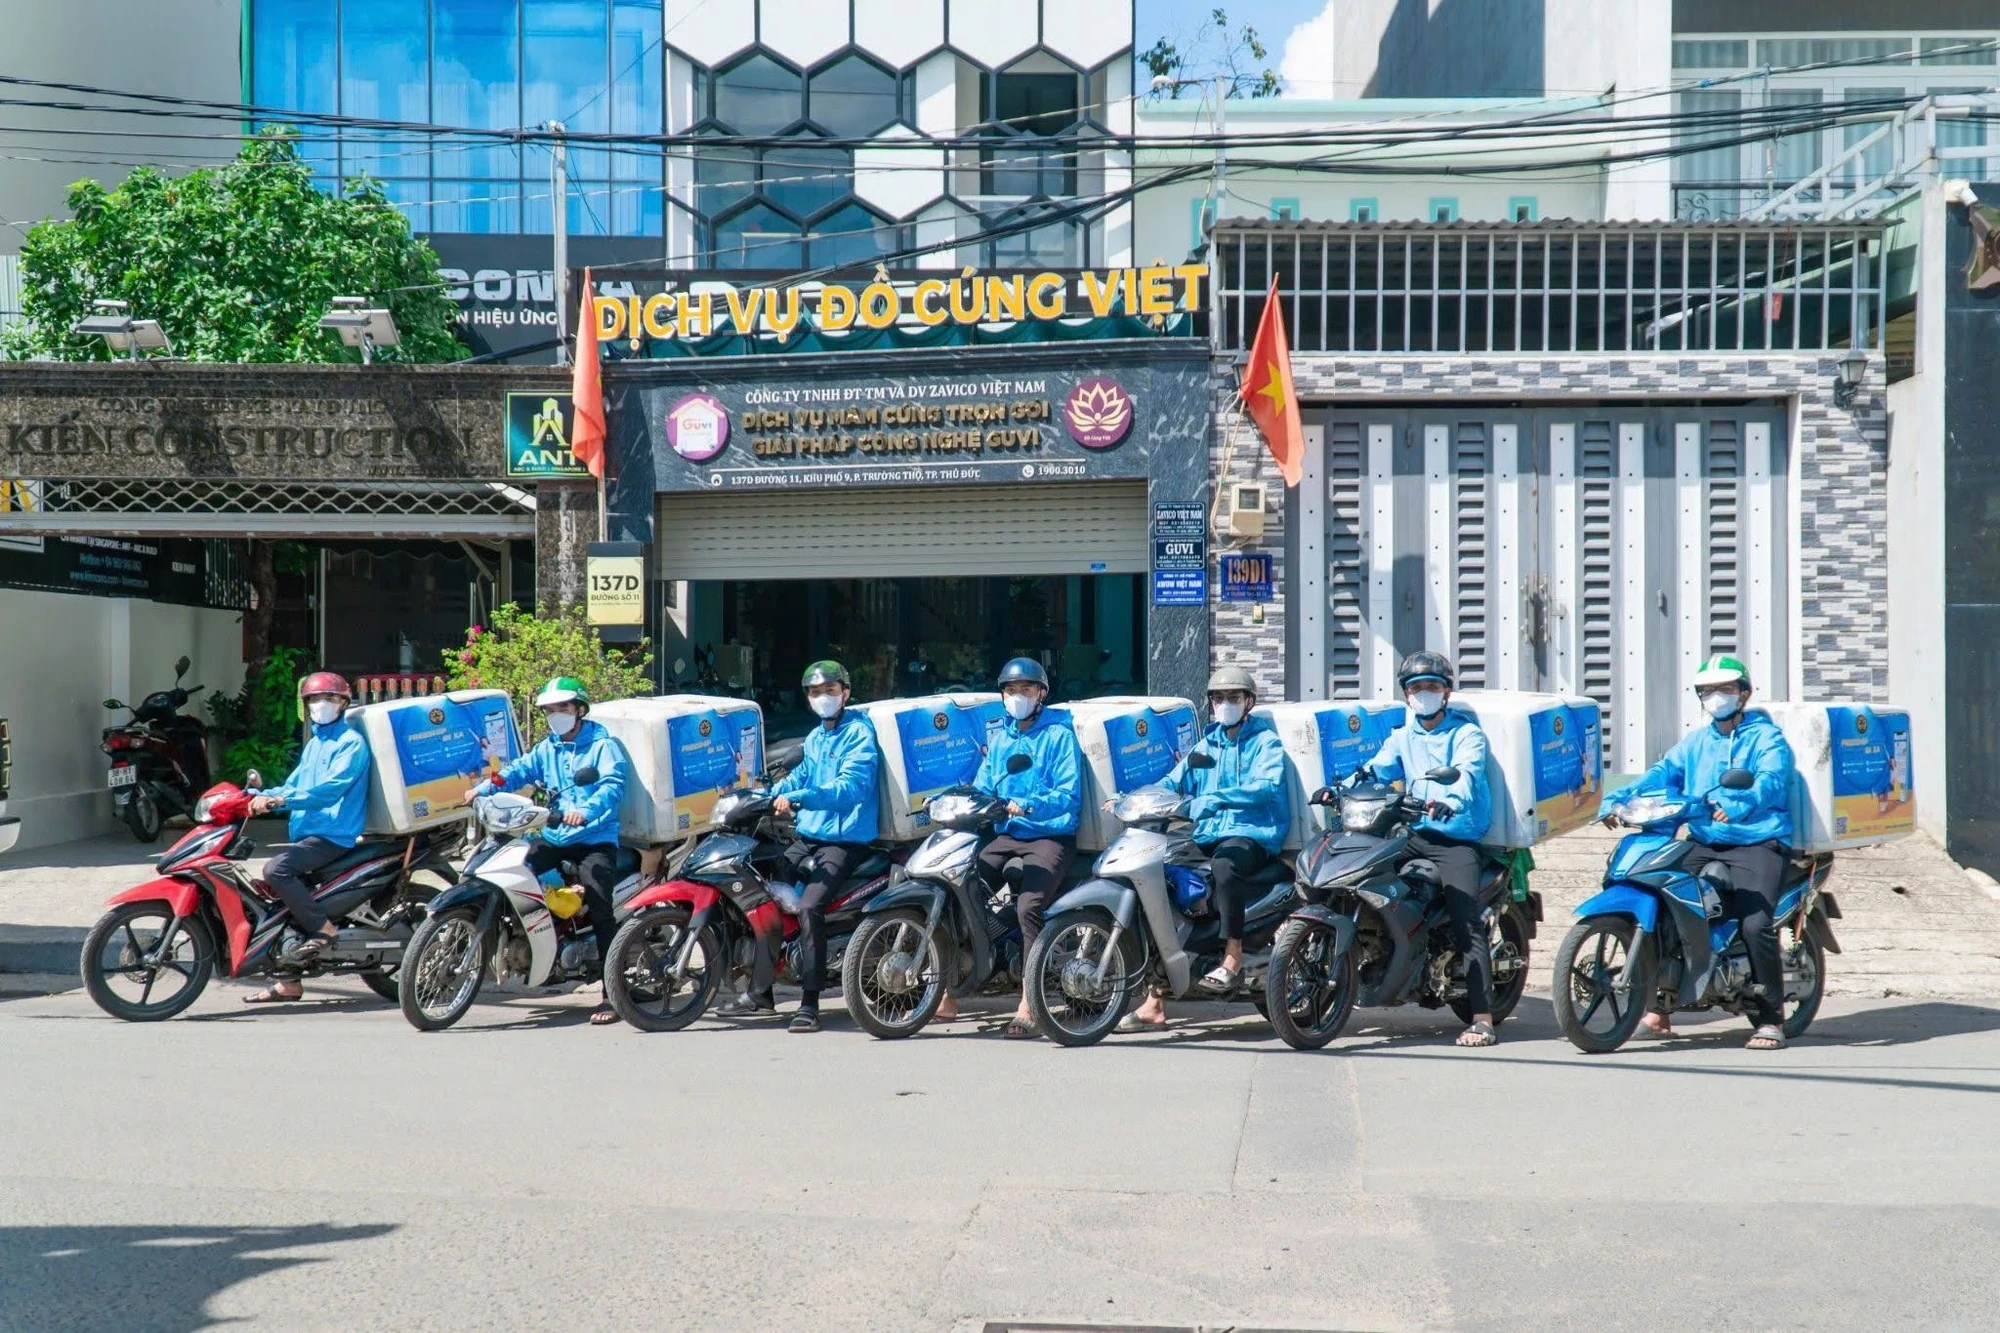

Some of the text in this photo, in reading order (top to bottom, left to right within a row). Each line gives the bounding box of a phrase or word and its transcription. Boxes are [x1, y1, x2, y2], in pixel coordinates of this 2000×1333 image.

[594, 257, 1209, 350] DỊCH VỤ ĐỒ CÚNG VIỆT
[474, 308, 515, 328] HIỆU
[520, 308, 557, 325] ỨNG
[745, 390, 780, 404] CÔNG
[783, 390, 800, 403] TY
[803, 389, 840, 402] TNHH
[844, 387, 862, 400] ĐT
[865, 387, 885, 400] TM
[908, 386, 927, 398] DV
[930, 384, 977, 398] ZAVICO
[982, 380, 1012, 397] VIỆT
[1015, 381, 1045, 394] NAM
[742, 400, 1049, 432] DỊCH VỤ MÂM CÚNG TRỌN GÓI
[4, 410, 473, 458] KIẾN CONSTRUCTION
[799, 433, 852, 454] PHÁP
[858, 430, 918, 452] CÔNG
[923, 429, 982, 451] NGHỆ
[986, 429, 1040, 447] GUVI
[517, 450, 577, 466] ANT
[731, 476, 753, 485] 137D
[755, 473, 787, 485] ĐƯỜNG
[803, 475, 823, 484] KHU
[825, 472, 843, 483] PHỐ
[862, 471, 901, 482] TRƯỜNG
[926, 470, 938, 479] TP.
[941, 468, 959, 479] THỦ
[960, 467, 981, 479] ĐỨC
[1038, 466, 1085, 476] 1900.3010
[1165, 543, 1194, 555] GUVI
[591, 575, 639, 591] 137D
[591, 592, 619, 601] ĐƯỜNG
[621, 591, 632, 601] SỐ
